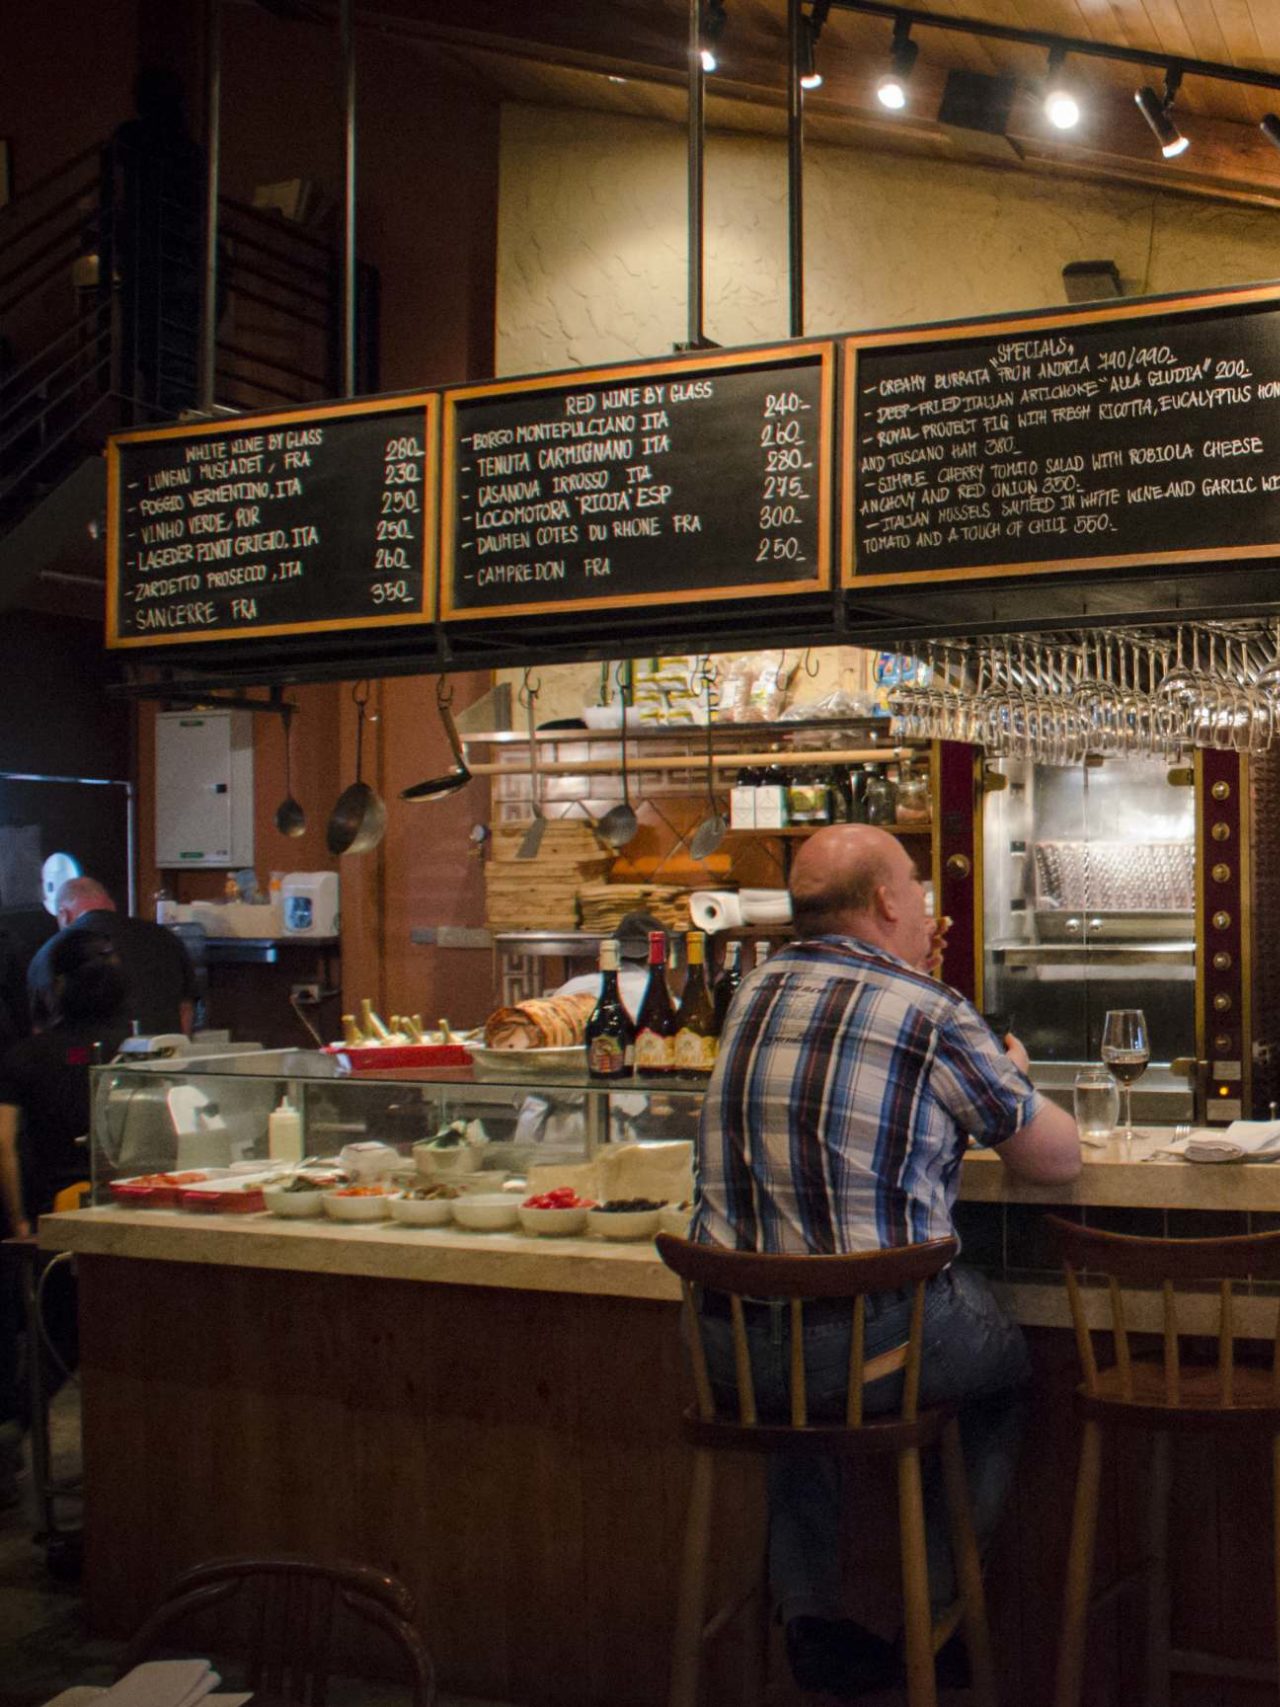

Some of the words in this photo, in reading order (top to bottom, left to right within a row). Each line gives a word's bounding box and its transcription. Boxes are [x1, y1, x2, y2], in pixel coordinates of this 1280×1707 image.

[879, 375, 927, 396] CREAMY
[934, 368, 991, 389] BURRATA
[999, 365, 1031, 383] FROM
[1038, 355, 1090, 379] ANDRIA
[566, 394, 596, 416] RED
[602, 388, 639, 409] WINE
[645, 387, 664, 403] BY
[670, 382, 714, 402] GLASS
[963, 391, 1015, 412] ITALIAN
[1020, 379, 1099, 404] ARTICHOKE
[473, 430, 513, 450] BORGO
[517, 414, 635, 443] MONTEPULCIANO
[642, 411, 670, 431] ITA
[878, 427, 919, 447] ROYAL
[922, 419, 977, 440] PROJECT
[984, 414, 1009, 432] FIG
[1018, 410, 1047, 428] WITH
[1051, 405, 1090, 423] FRESH
[1157, 386, 1251, 412] EUCALYPTUS
[186, 444, 226, 463] WHITE
[232, 438, 263, 455] WINE
[269, 435, 284, 449] BY
[286, 429, 322, 448] GLASS
[285, 452, 311, 470] FRA
[477, 452, 531, 478] TENUTA
[539, 439, 632, 468] CARMIGNANO
[642, 436, 672, 456] ITA
[861, 457, 885, 473] AND
[888, 446, 944, 466] TUSCANO
[952, 441, 977, 458] HAM
[938, 464, 985, 485] CHERRY
[991, 461, 1038, 477] TOMATO
[1046, 456, 1083, 473] SALAD
[1092, 452, 1122, 470] WITH
[1129, 444, 1194, 464] ROBIOLA
[1203, 437, 1264, 458] CHEESE
[276, 478, 302, 498] ITA
[478, 481, 540, 507] CASANOVA
[626, 466, 652, 485] ITA
[860, 491, 916, 516] ANCHOVY
[922, 487, 949, 504] AND
[958, 483, 985, 499] RED
[992, 479, 1037, 498] ONION
[475, 500, 569, 529] LOCOMOTORA
[636, 486, 672, 508] ESP
[882, 512, 929, 532] ITALIAN
[938, 503, 991, 522] MUSSELS
[1061, 495, 1075, 510] IN
[1081, 491, 1120, 509] WHITE
[1127, 486, 1164, 503] WINE
[1163, 481, 1195, 498] AND
[1202, 479, 1257, 496] GARLIC
[141, 519, 183, 544] VINHO
[236, 506, 260, 527] POR
[536, 526, 578, 545] COTES
[589, 524, 607, 541] DU
[612, 517, 661, 539] RHONE
[673, 514, 701, 534] FRA
[863, 534, 910, 553] TOMATO
[917, 530, 942, 546] AND
[961, 522, 1000, 541] TOUCH
[1007, 522, 1024, 537] OF
[1029, 517, 1066, 533] CHILI
[197, 539, 232, 562] PINOT
[291, 527, 319, 546] ITA
[135, 575, 199, 601] ZARDETTO
[207, 565, 266, 589] PROSECCO
[477, 561, 564, 586] CAMPREDON
[584, 558, 611, 578] FRA
[135, 602, 218, 630] SANCERRE
[231, 599, 258, 619] FRA
